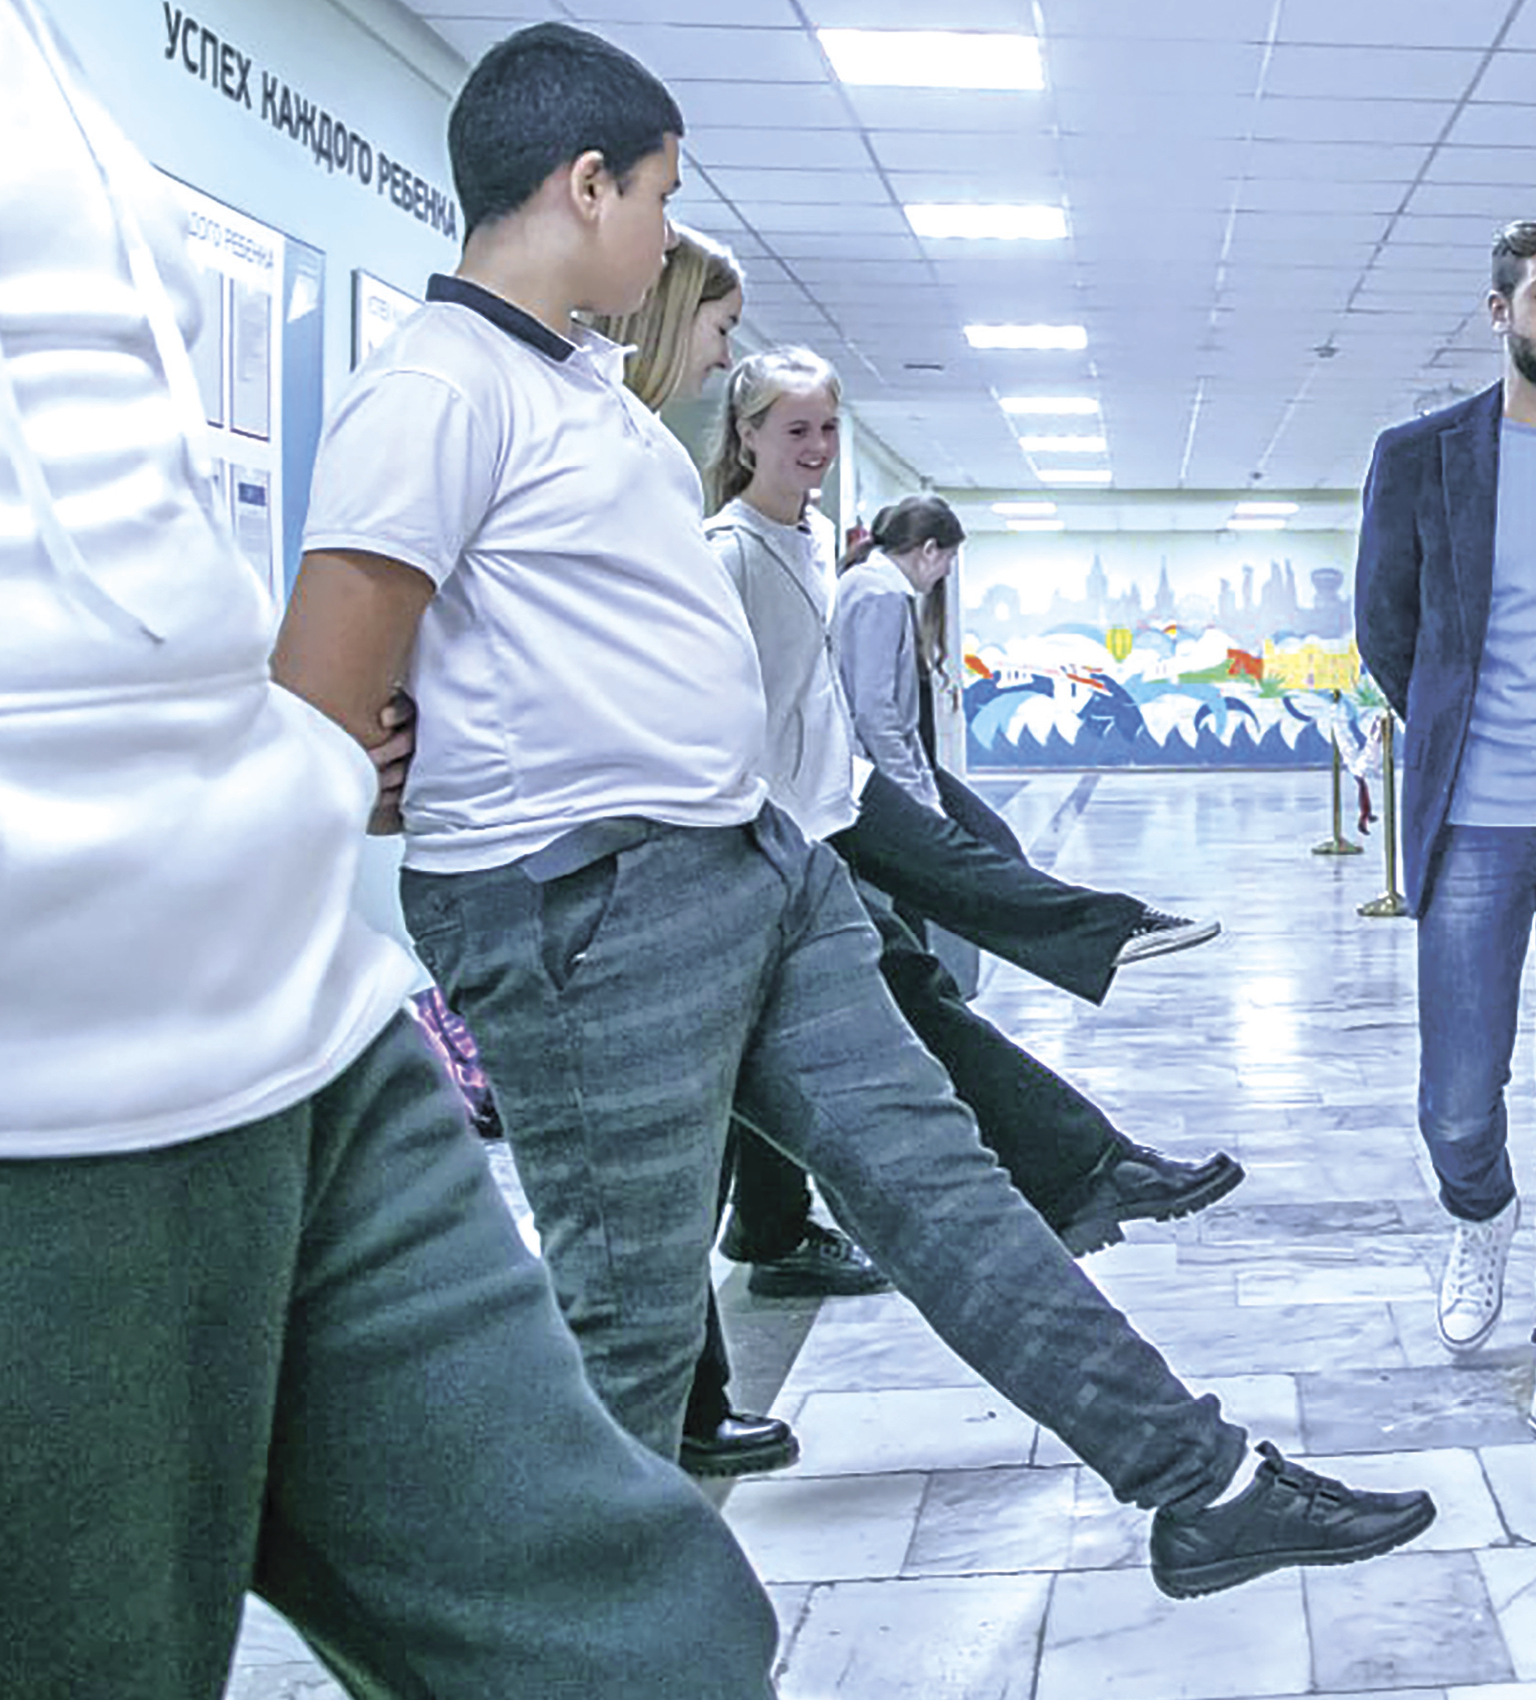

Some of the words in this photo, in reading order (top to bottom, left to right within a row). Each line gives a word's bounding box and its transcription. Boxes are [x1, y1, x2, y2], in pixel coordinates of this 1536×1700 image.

[163, 1, 252, 110] УСПЕХ
[261, 70, 373, 186] КАЖДОГО
[377, 151, 458, 241] РЕБЕНКА
